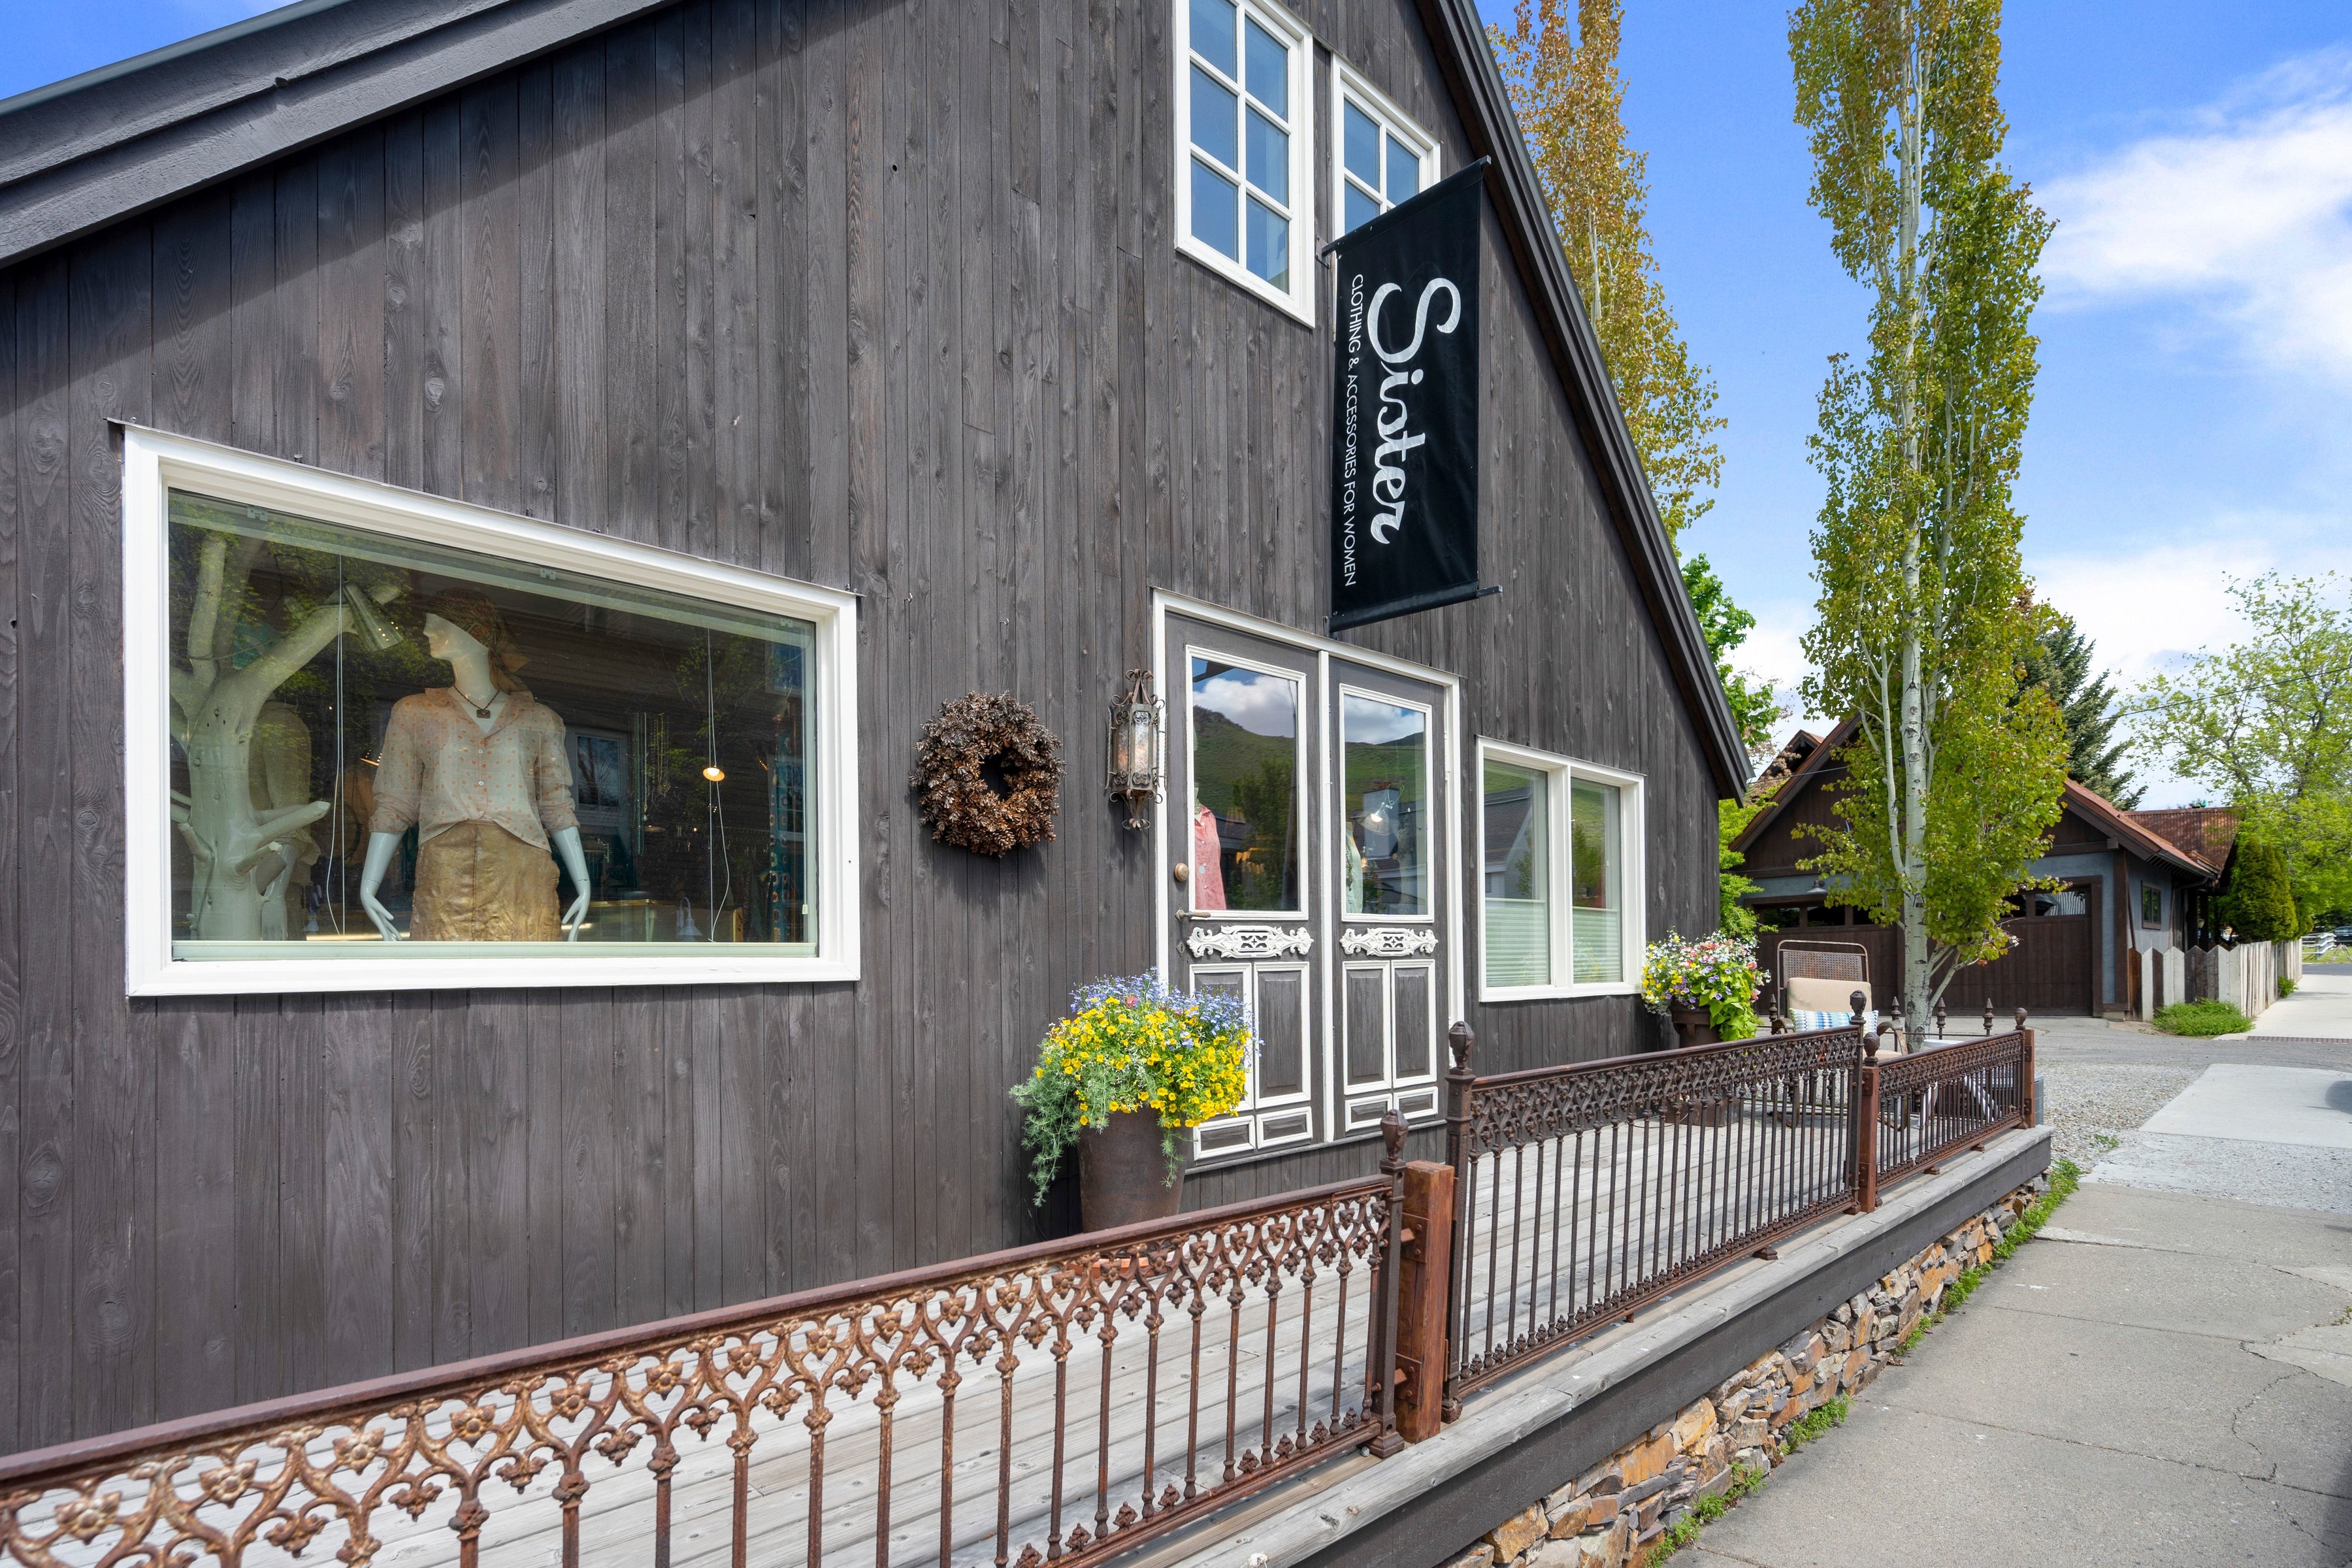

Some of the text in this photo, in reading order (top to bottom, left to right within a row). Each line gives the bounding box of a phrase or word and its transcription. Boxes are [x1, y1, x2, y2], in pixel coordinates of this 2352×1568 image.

[1343, 274, 1364, 587] CLOTHING & ACCESSORIES FOR WOMEN
[1367, 277, 1462, 545] Sister
